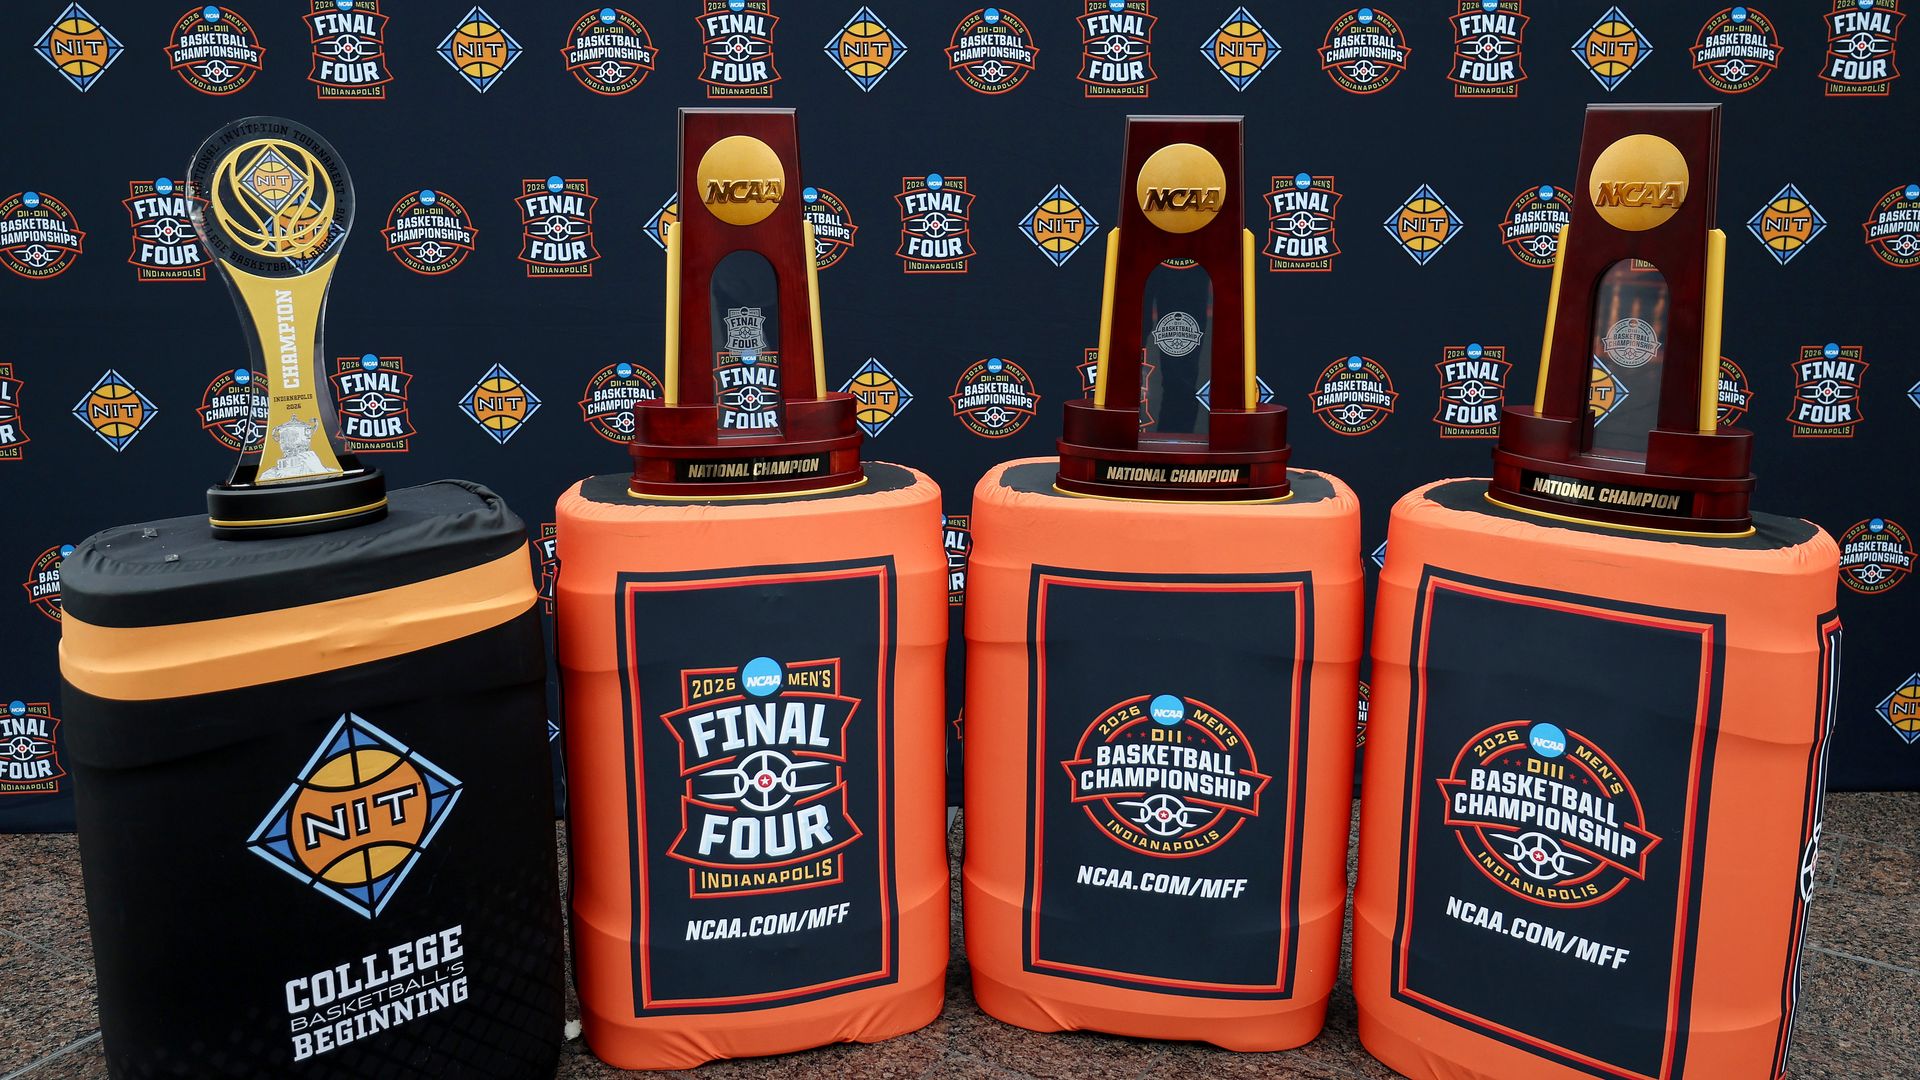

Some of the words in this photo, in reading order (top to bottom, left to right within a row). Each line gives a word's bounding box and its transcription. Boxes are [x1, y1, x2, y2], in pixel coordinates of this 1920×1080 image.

[1089, 2, 1106, 11] 2026
[179, 13, 200, 30] 2026
[314, 14, 376, 36] FINAL
[706, 15, 766, 36] FINAL
[960, 15, 980, 32] 2026
[1087, 15, 1144, 36] FINAL
[1459, 14, 1516, 36] FINAL
[1833, 12, 1892, 34] FINAL
[56, 41, 103, 55] NIT
[180, 33, 248, 48] BASKETBALL
[577, 35, 642, 49] BASKETBALL
[960, 34, 1023, 48] BASKETBALL
[1334, 34, 1396, 48] BASKETBALL
[1705, 33, 1768, 48] BASKETBALL
[174, 46, 257, 62] CHAMPIONSHIPS
[458, 43, 502, 57] NIT
[570, 48, 650, 63] CHAMPIONSHIPS
[845, 43, 888, 56] NIT
[954, 47, 1030, 62] CHAMPIONSHIPS
[1220, 43, 1262, 56] NIT
[1326, 47, 1402, 62] CHAMPIONSHIPS
[1591, 42, 1634, 56] NIT
[1697, 46, 1775, 61] CHAMPIONSHIPS
[320, 61, 380, 83] FOUR
[711, 61, 768, 82] FOUR
[1089, 60, 1144, 81] FOUR
[1460, 60, 1515, 81] FOUR
[1831, 59, 1888, 80] FOUR
[190, 77, 245, 92] INDIANAPOLIS
[585, 77, 637, 92] INDIANAPOLIS
[712, 86, 768, 94] INDIANAPOLIS
[967, 76, 1018, 90] INDIANAPOLIS
[1090, 85, 1144, 94] INDIANAPOLIS
[1338, 76, 1388, 90] INDIANAPOLIS
[1459, 85, 1513, 94] INDIANAPOLIS
[1708, 75, 1759, 90] INDIANAPOLIS
[1830, 84, 1885, 92] INDIANAPOLIS
[322, 86, 380, 95] INDIANAPOLIS
[257, 175, 289, 187] NIT
[527, 184, 545, 192] 2026
[705, 178, 783, 204] NCAA
[1595, 182, 1684, 209] NCAA
[396, 197, 416, 213] 2026
[526, 196, 584, 217] FINAL
[905, 193, 962, 214] FINAL
[1143, 187, 1222, 212] NCAA
[1273, 192, 1329, 213] FINAL
[0, 218, 68, 233] BASKETBALL
[397, 216, 462, 230] BASKETBALL
[1038, 220, 1080, 232] NIT
[1403, 219, 1444, 231] NIT
[1766, 218, 1808, 231] NIT
[0, 231, 78, 246] HAMPIONSHIPS
[390, 228, 470, 243] CHAMPIONSHIPS
[530, 241, 587, 261] FOUR
[908, 237, 963, 257] FOUR
[1274, 236, 1328, 256] FOUR
[140, 244, 200, 265] FOUR
[11, 261, 66, 275] INDIANAPOLIS
[405, 257, 458, 271] INDIANAPOLIS
[532, 265, 587, 273] INDIANAPOLIS
[909, 261, 963, 269] INDIANAPOLIS
[1275, 260, 1327, 268] INDIANAPOLIS
[143, 269, 201, 277] INDIANAPOLIS
[730, 317, 758, 328] FINAL
[275, 290, 300, 389] CHAMPION
[732, 338, 758, 348] FOUR
[1614, 333, 1650, 342] BASKETBALL
[341, 362, 360, 370] 2026
[965, 365, 984, 380] 2026
[1444, 362, 1500, 382] FINAL
[1800, 361, 1856, 381] FINAL
[341, 373, 400, 394] FINAL
[719, 367, 777, 388] FINAL
[594, 387, 656, 401] BASKETBALL
[964, 382, 1025, 396] BASKETBALL
[1324, 380, 1384, 393] BASKETBALL
[273, 394, 312, 402] INDIANAPOLIS
[479, 397, 522, 410] NIT
[853, 392, 894, 404] NIT
[958, 394, 1032, 409] CHAMPIONSHIPS
[1317, 392, 1390, 406] CHAMPIONSHIPS
[93, 404, 138, 418] NIT
[1445, 404, 1498, 423] FOUR
[1798, 403, 1852, 423] FOUR
[346, 417, 403, 437] FOUR
[723, 410, 778, 430] FOUR
[1328, 419, 1377, 432] INDIANAPOLIS
[970, 422, 1019, 435] INDIANAPOLIS
[1798, 426, 1850, 434] INDIANAPOLIS
[348, 440, 403, 449] INDIANAPOLIS
[688, 464, 750, 478] NATIONAL
[753, 458, 819, 476] CHAMPION
[1106, 466, 1166, 482] NATIONAL
[1170, 469, 1239, 482] CHAMPION
[1533, 478, 1594, 500] NATIONAL
[1598, 488, 1680, 510] CHAMPION
[1846, 524, 1866, 539] 2026
[1845, 542, 1904, 554] BASKETBALL
[1847, 578, 1894, 591] INDIANAPOLIS
[692, 678, 736, 699] 2026
[746, 676, 781, 688] NCAA
[788, 670, 831, 688] MEN'S
[0, 718, 48, 737] INAL
[688, 702, 830, 758] FINAL
[1098, 706, 1140, 736] 2026
[1153, 708, 1183, 718] NCAA
[1193, 709, 1238, 748] MEN'S
[1152, 728, 1182, 744] DII
[1096, 744, 1235, 776] BASKETBALL
[1474, 730, 1520, 757] 2026
[1532, 736, 1564, 752] NCAA
[1576, 745, 1624, 795] MEN'S
[1527, 758, 1564, 780] DIII
[0, 782, 54, 791] NDIANAPOLIS
[1081, 767, 1251, 800] CHAMPIONSHIP
[1470, 768, 1619, 828] BASKETBALL
[304, 786, 415, 848] NIT
[698, 804, 834, 858] FOUR
[1454, 792, 1636, 858] CHAMPIONSHIP
[1106, 820, 1220, 851] INDIANAPOLIS
[701, 858, 833, 889] INDIANAPOLIS
[1478, 852, 1598, 900] INDIANAPOLIS
[1076, 865, 1248, 899] NCAA.COM/MFF
[686, 902, 850, 941] NCAA.COM/MFF
[1446, 896, 1630, 969] NCAA.COM/MFF
[285, 925, 463, 1014] COLLEGE
[291, 961, 465, 1032] BASKETBALL'S
[291, 976, 468, 1062] BEGINNING
